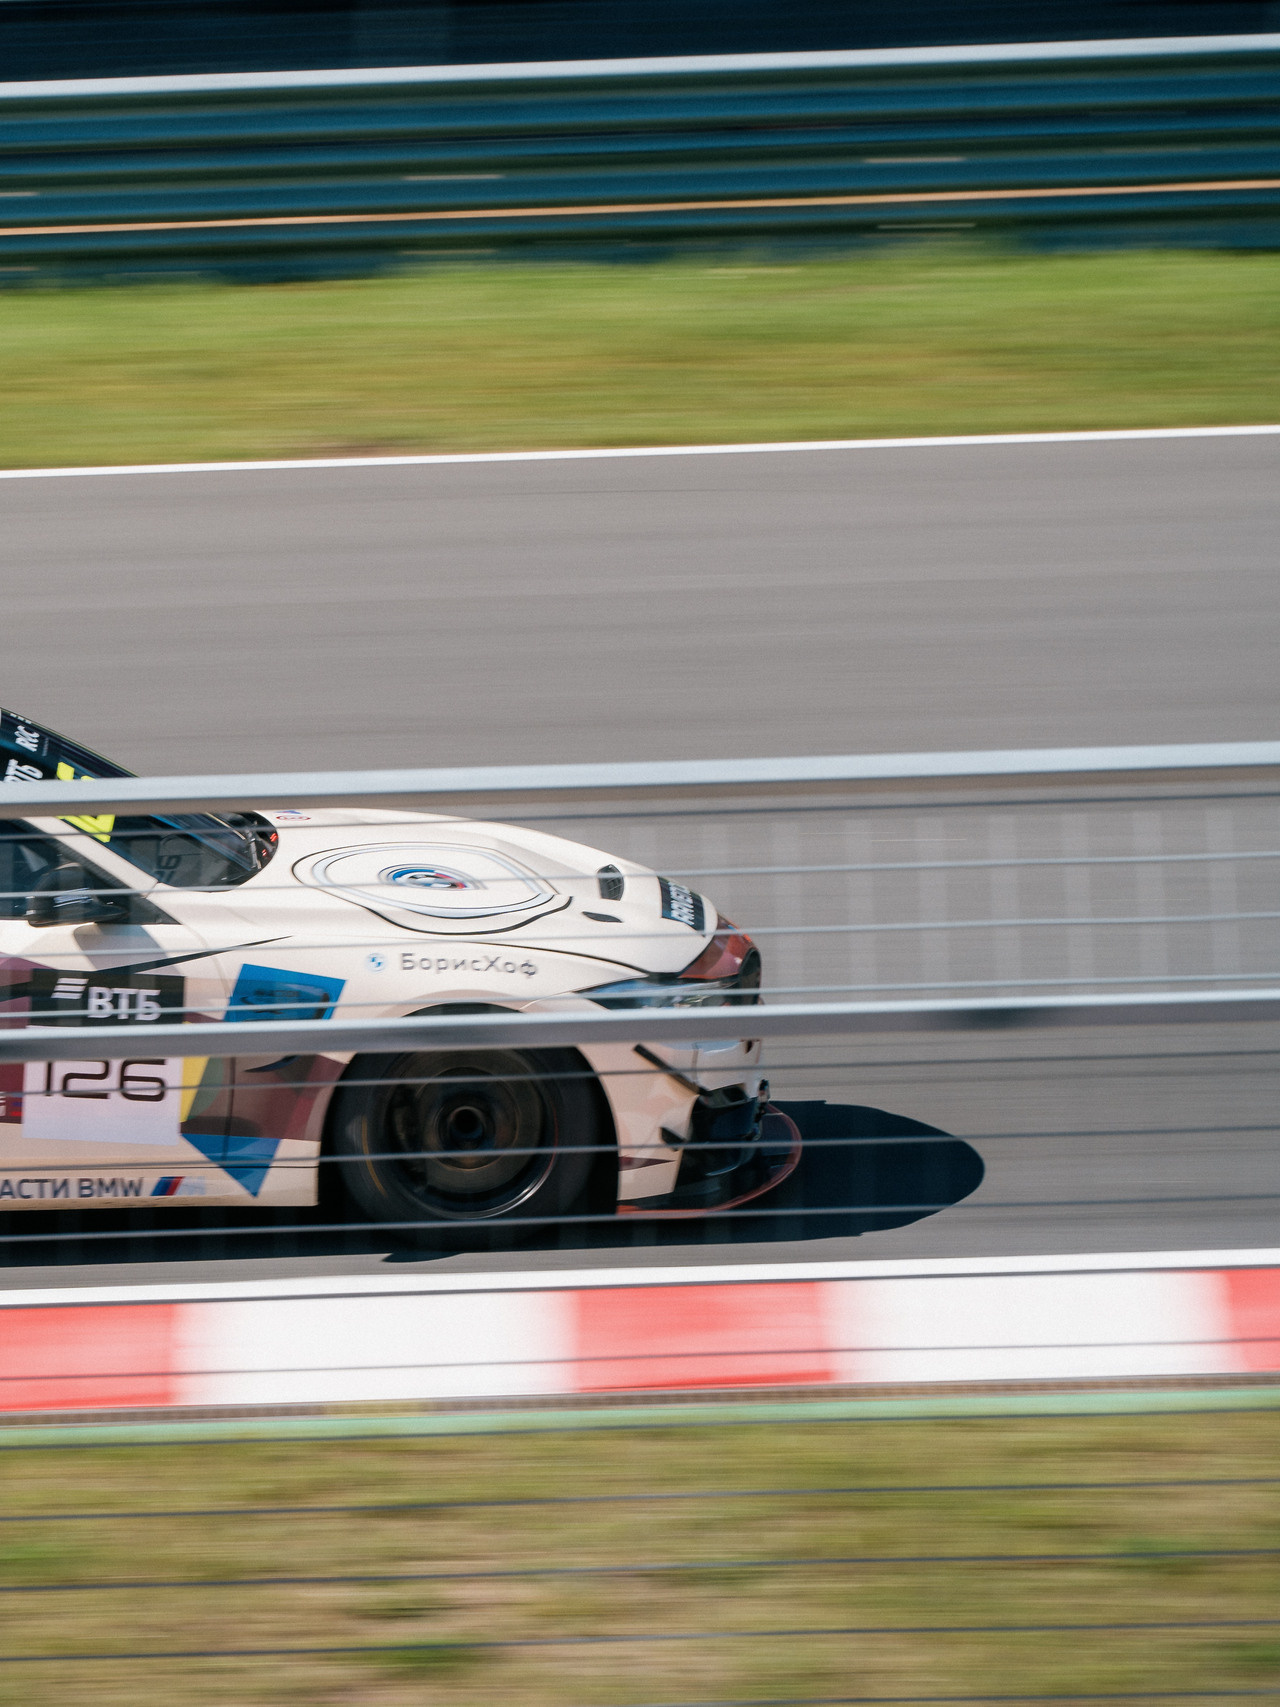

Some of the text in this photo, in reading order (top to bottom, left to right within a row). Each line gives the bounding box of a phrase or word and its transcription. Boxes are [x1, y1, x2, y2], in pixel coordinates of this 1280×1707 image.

[399, 952, 538, 979] БорисХоф
[87, 986, 162, 1021] ВТБ
[44, 1058, 166, 1102] 126
[77, 1177, 144, 1198] BMW
